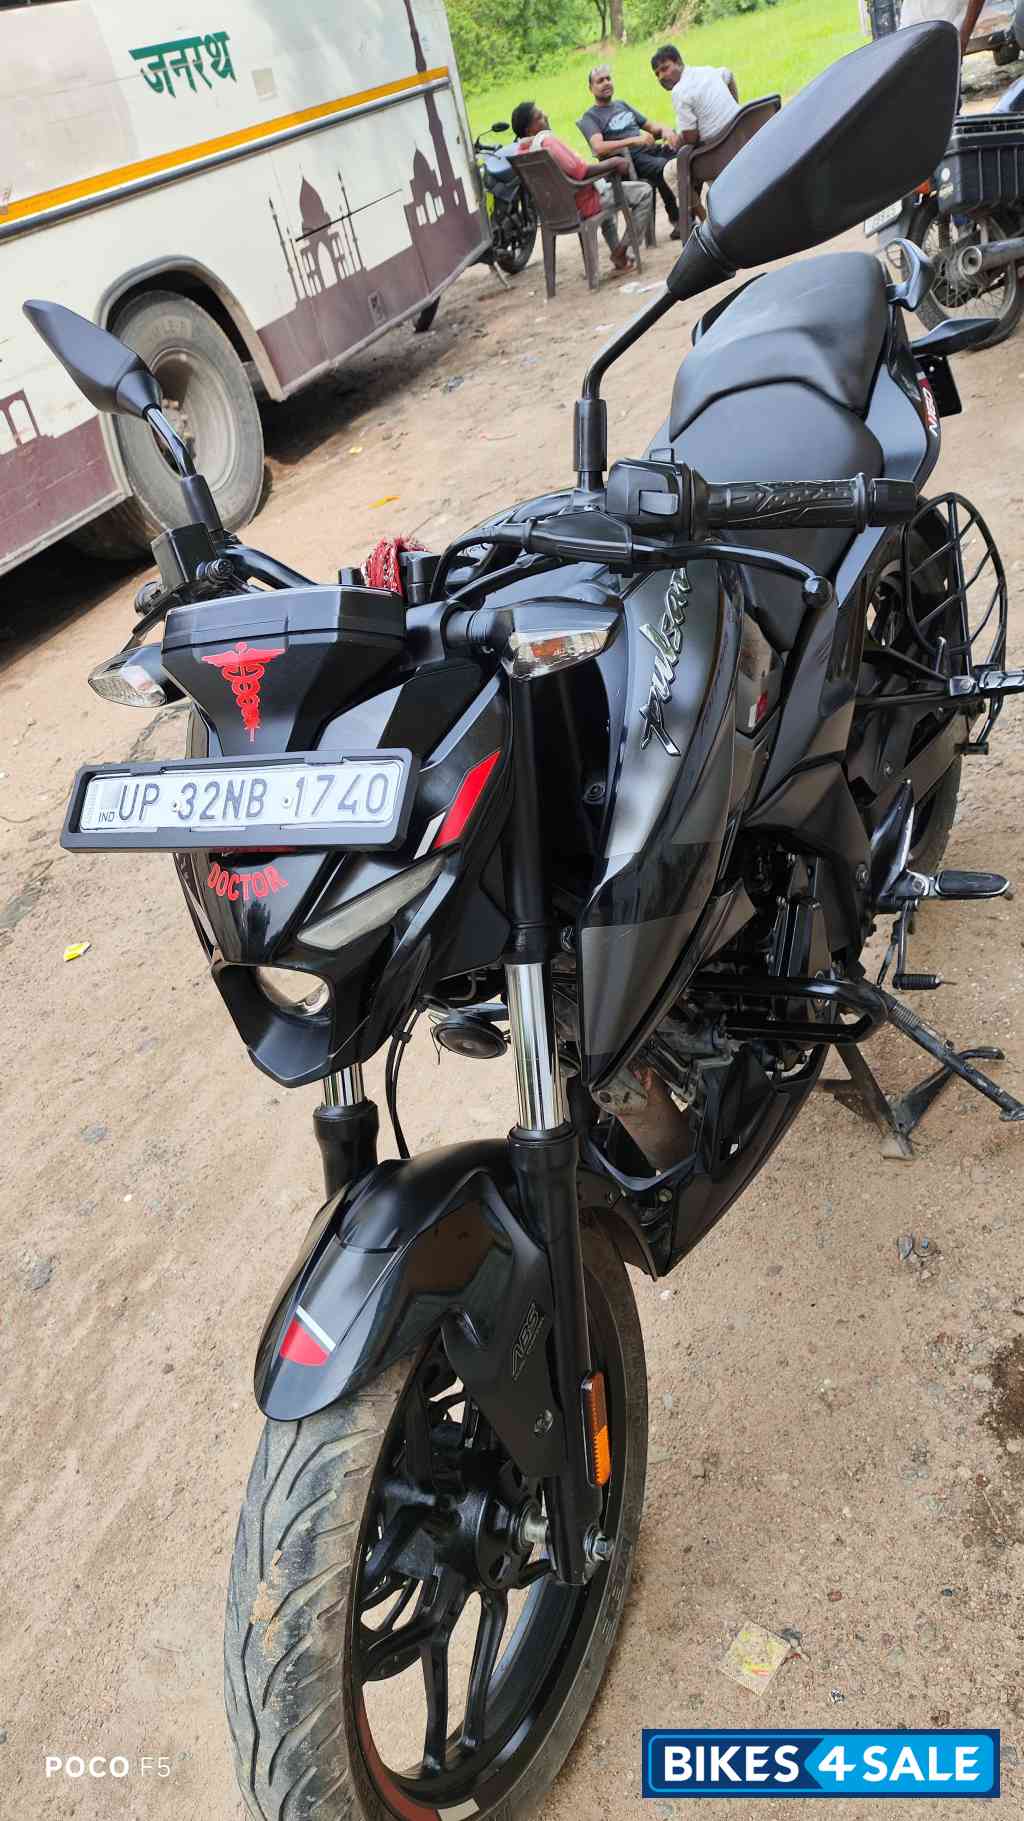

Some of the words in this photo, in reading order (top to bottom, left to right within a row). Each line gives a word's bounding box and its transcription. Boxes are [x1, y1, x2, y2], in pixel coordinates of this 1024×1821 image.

[128, 31, 237, 99] जनरथ
[98, 810, 115, 822] IND
[118, 782, 161, 822] UP
[177, 778, 269, 821] 32NB
[293, 772, 390, 818] 1740
[207, 862, 289, 901] DOCTOR
